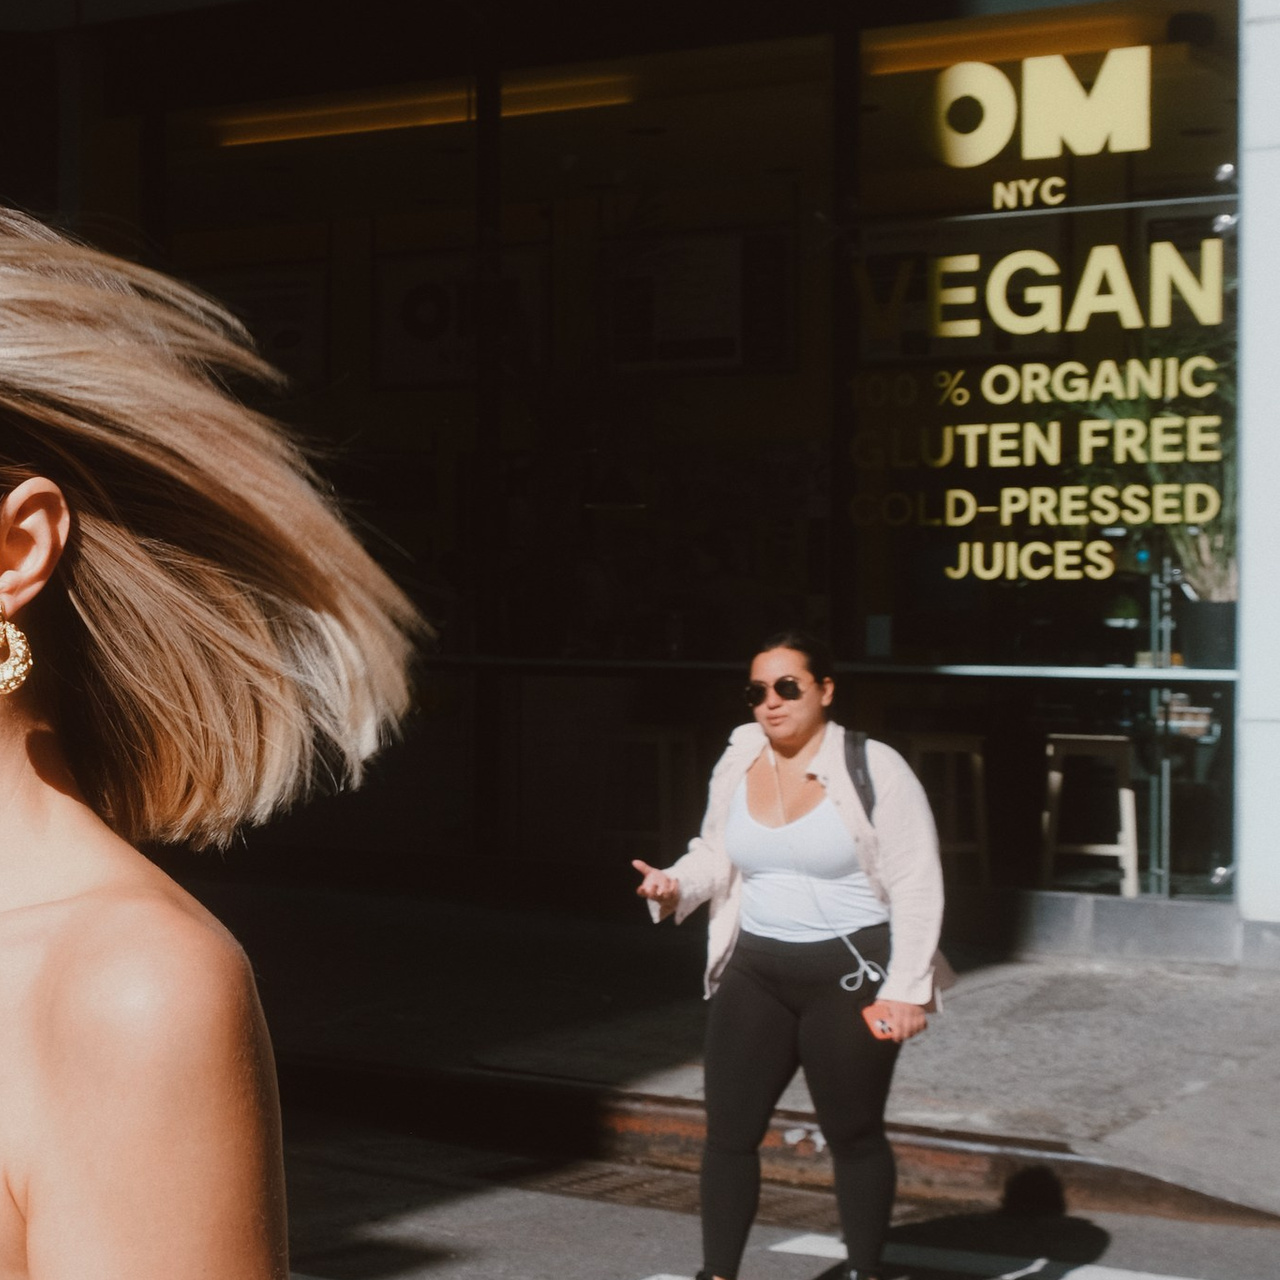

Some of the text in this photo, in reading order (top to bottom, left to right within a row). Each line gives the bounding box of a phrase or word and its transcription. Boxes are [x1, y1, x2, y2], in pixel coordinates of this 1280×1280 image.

[935, 45, 1152, 169] OM
[992, 176, 1067, 211] NYC
[980, 355, 1218, 406] ORGANIC
[1078, 415, 1222, 465] FREE
[945, 542, 1115, 581] JUICES
